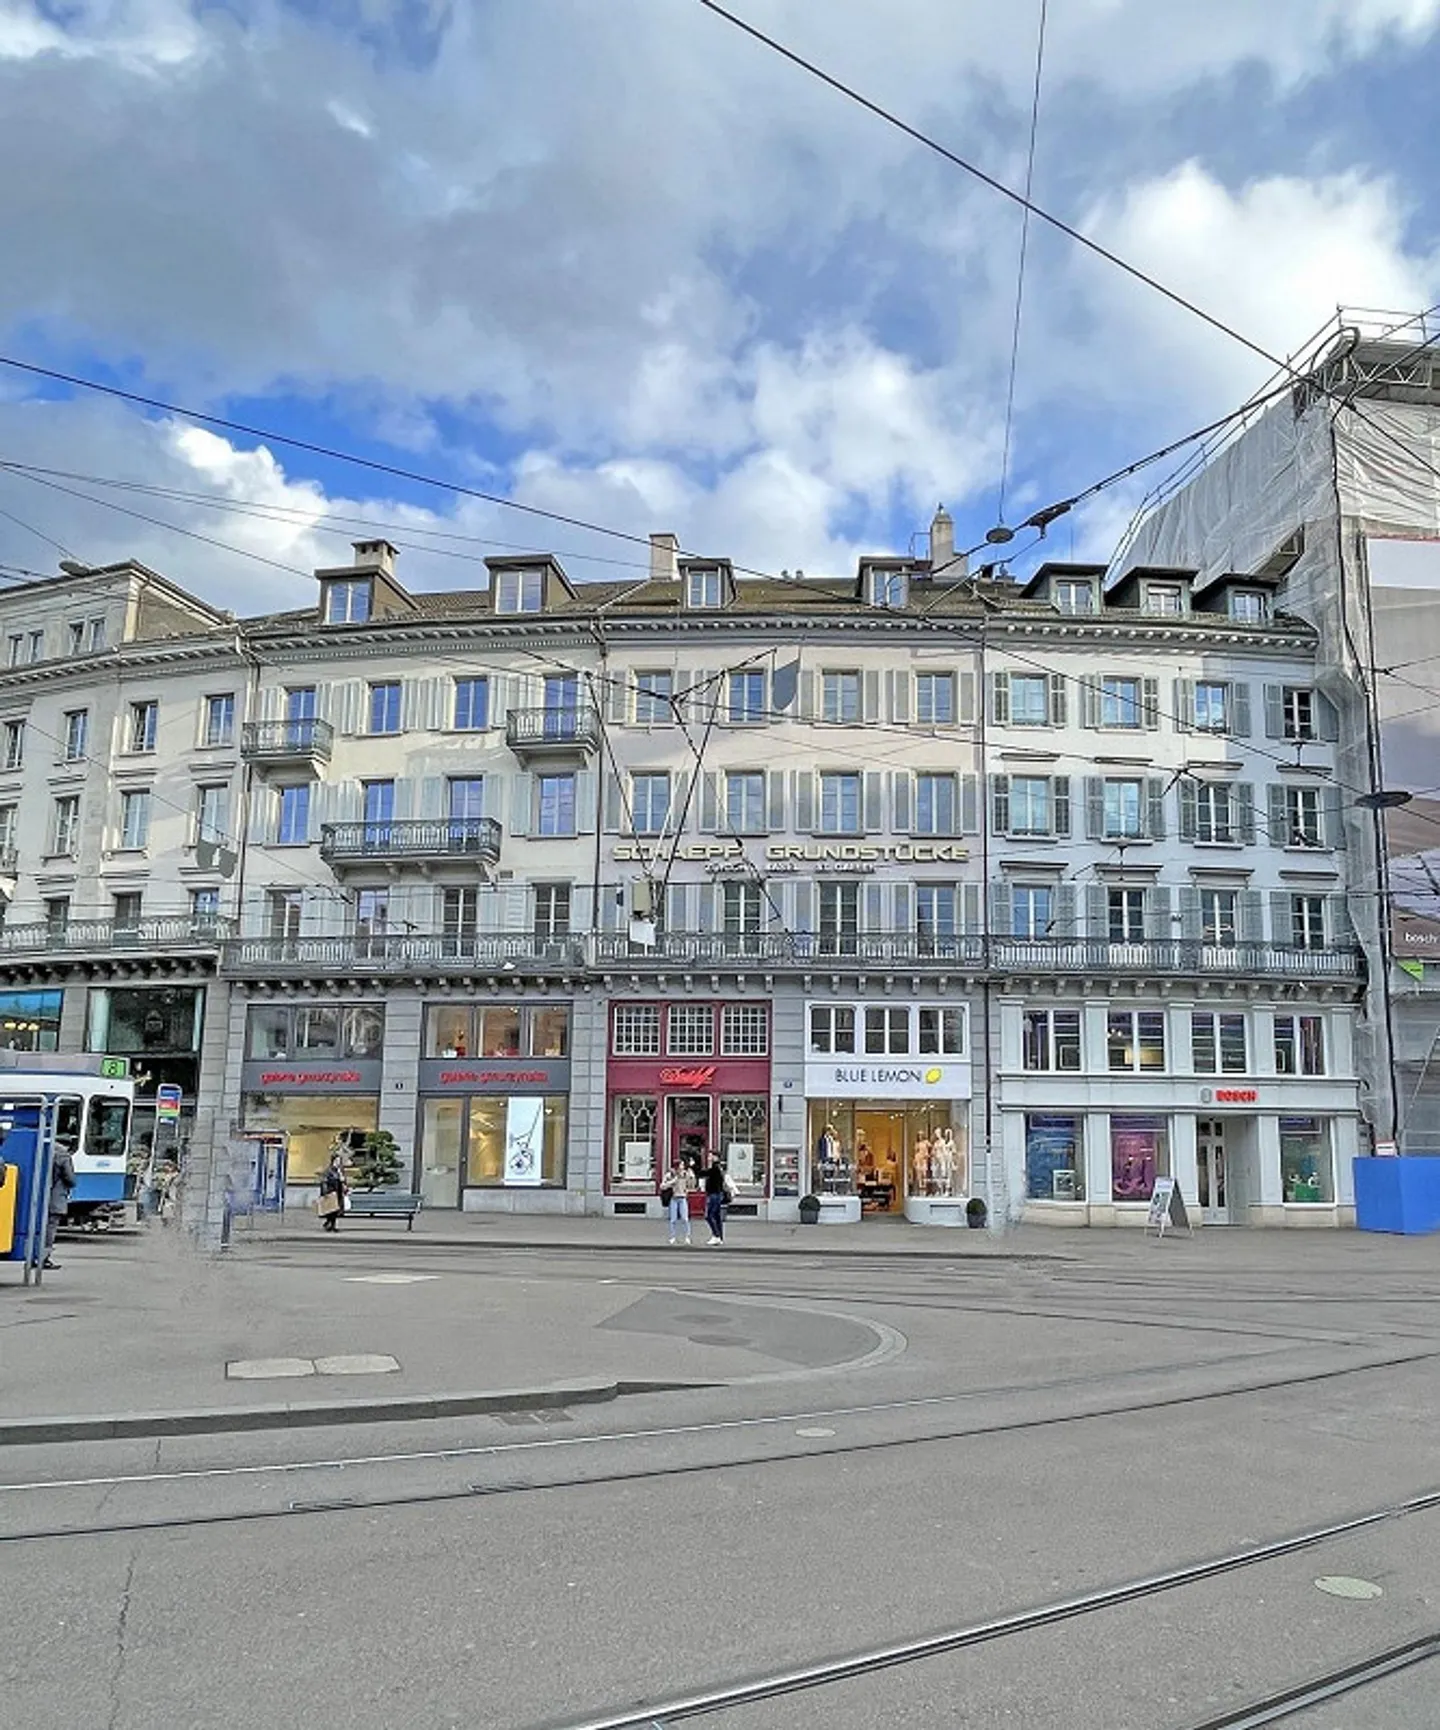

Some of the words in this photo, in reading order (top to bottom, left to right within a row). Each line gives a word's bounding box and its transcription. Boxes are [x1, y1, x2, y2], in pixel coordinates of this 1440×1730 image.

[765, 843, 969, 862] GRUNDSTÜCKE
[835, 1069, 867, 1083] BLUE
[871, 1069, 921, 1083] LEMON
